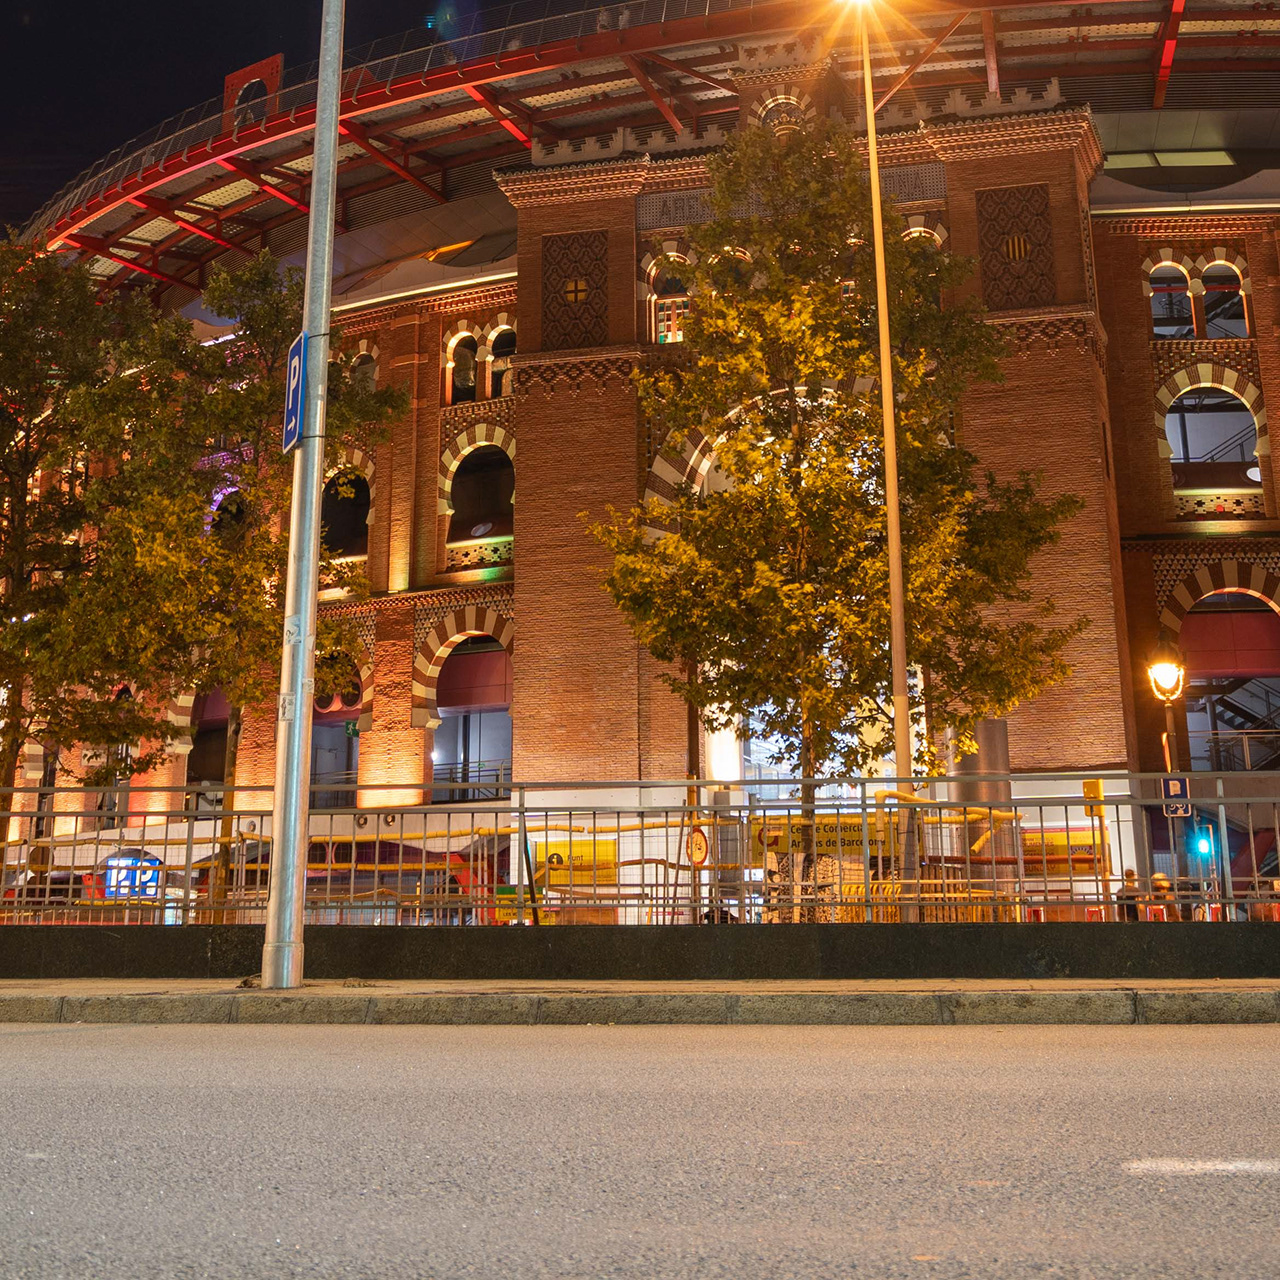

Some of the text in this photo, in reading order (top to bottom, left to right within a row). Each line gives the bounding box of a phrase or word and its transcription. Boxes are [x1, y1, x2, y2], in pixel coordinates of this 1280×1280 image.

[288, 355, 300, 410] P
[825, 838, 837, 847] de
[840, 838, 886, 847] Barceona
